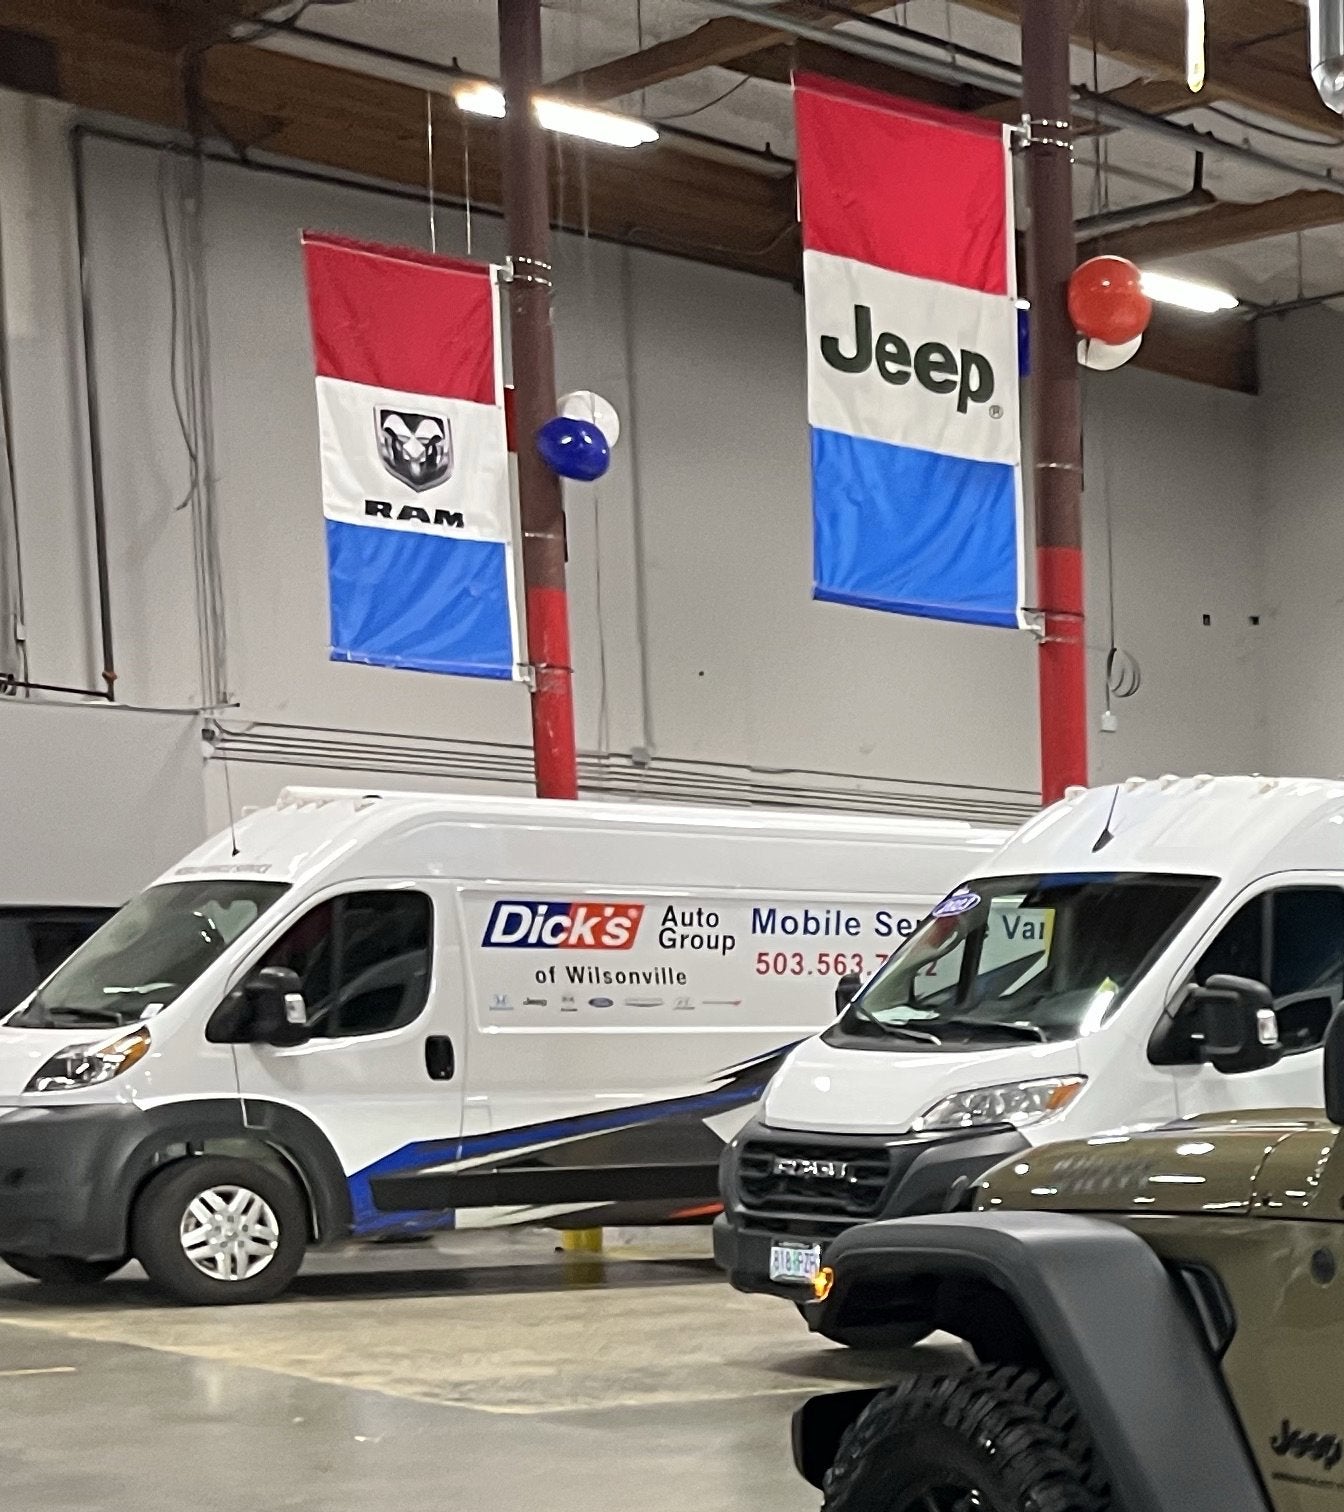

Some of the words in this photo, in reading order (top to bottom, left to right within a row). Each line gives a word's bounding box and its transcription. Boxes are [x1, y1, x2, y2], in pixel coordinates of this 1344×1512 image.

[820, 303, 995, 414] Jeep
[364, 499, 464, 529] RAM
[490, 904, 632, 946] Dick's
[661, 904, 720, 928] Auto
[751, 907, 862, 936] Mobile
[658, 927, 736, 956] Group
[535, 965, 556, 985] of
[565, 965, 687, 986] Wilsonville
